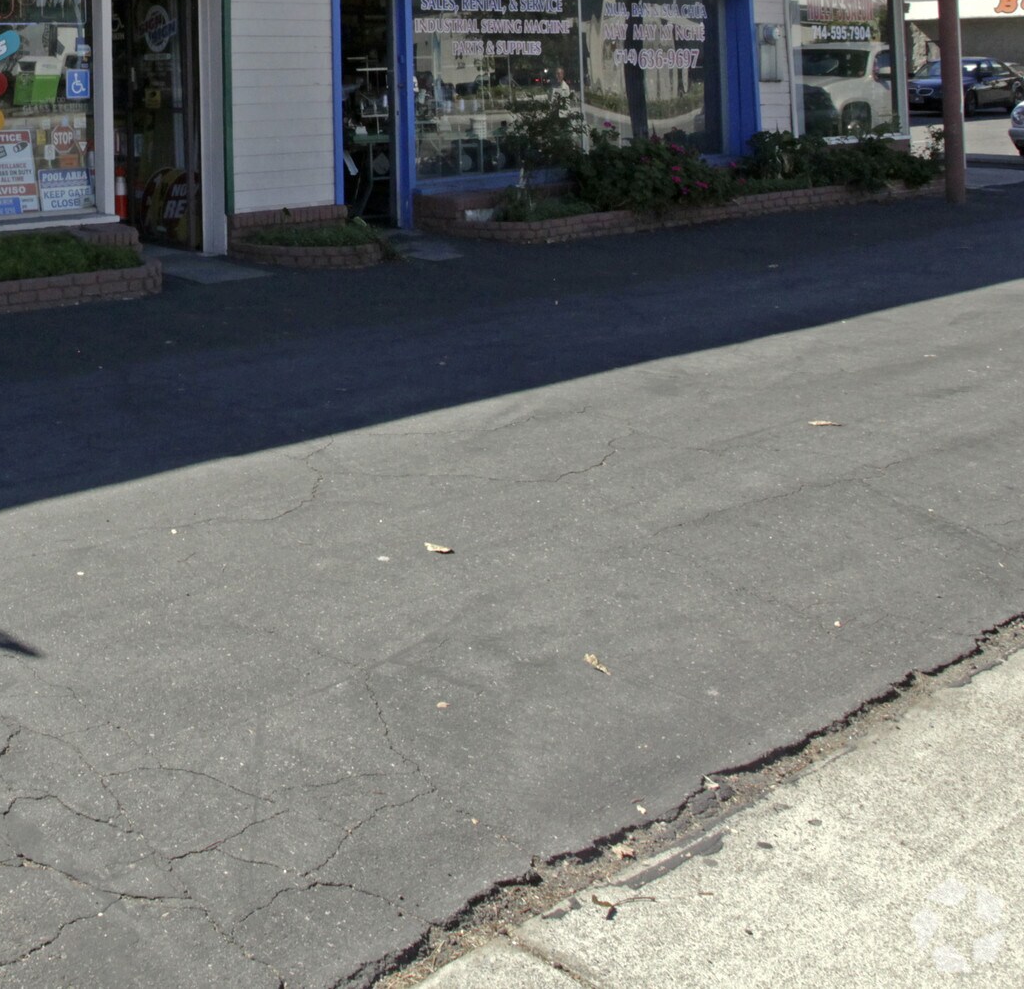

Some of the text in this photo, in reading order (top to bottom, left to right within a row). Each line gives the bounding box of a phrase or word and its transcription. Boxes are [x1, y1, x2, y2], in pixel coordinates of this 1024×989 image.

[414, 18, 479, 33] INDUSTRIAL
[481, 19, 522, 34] SEWING
[810, 25, 871, 40] 714-595-7904
[452, 41, 542, 56] PARTS & SUPPLIES
[638, 48, 700, 69] 636-9697
[54, 132, 73, 145] STOP
[42, 171, 88, 182] POOL AREA
[43, 188, 91, 199] KEEP GATE
